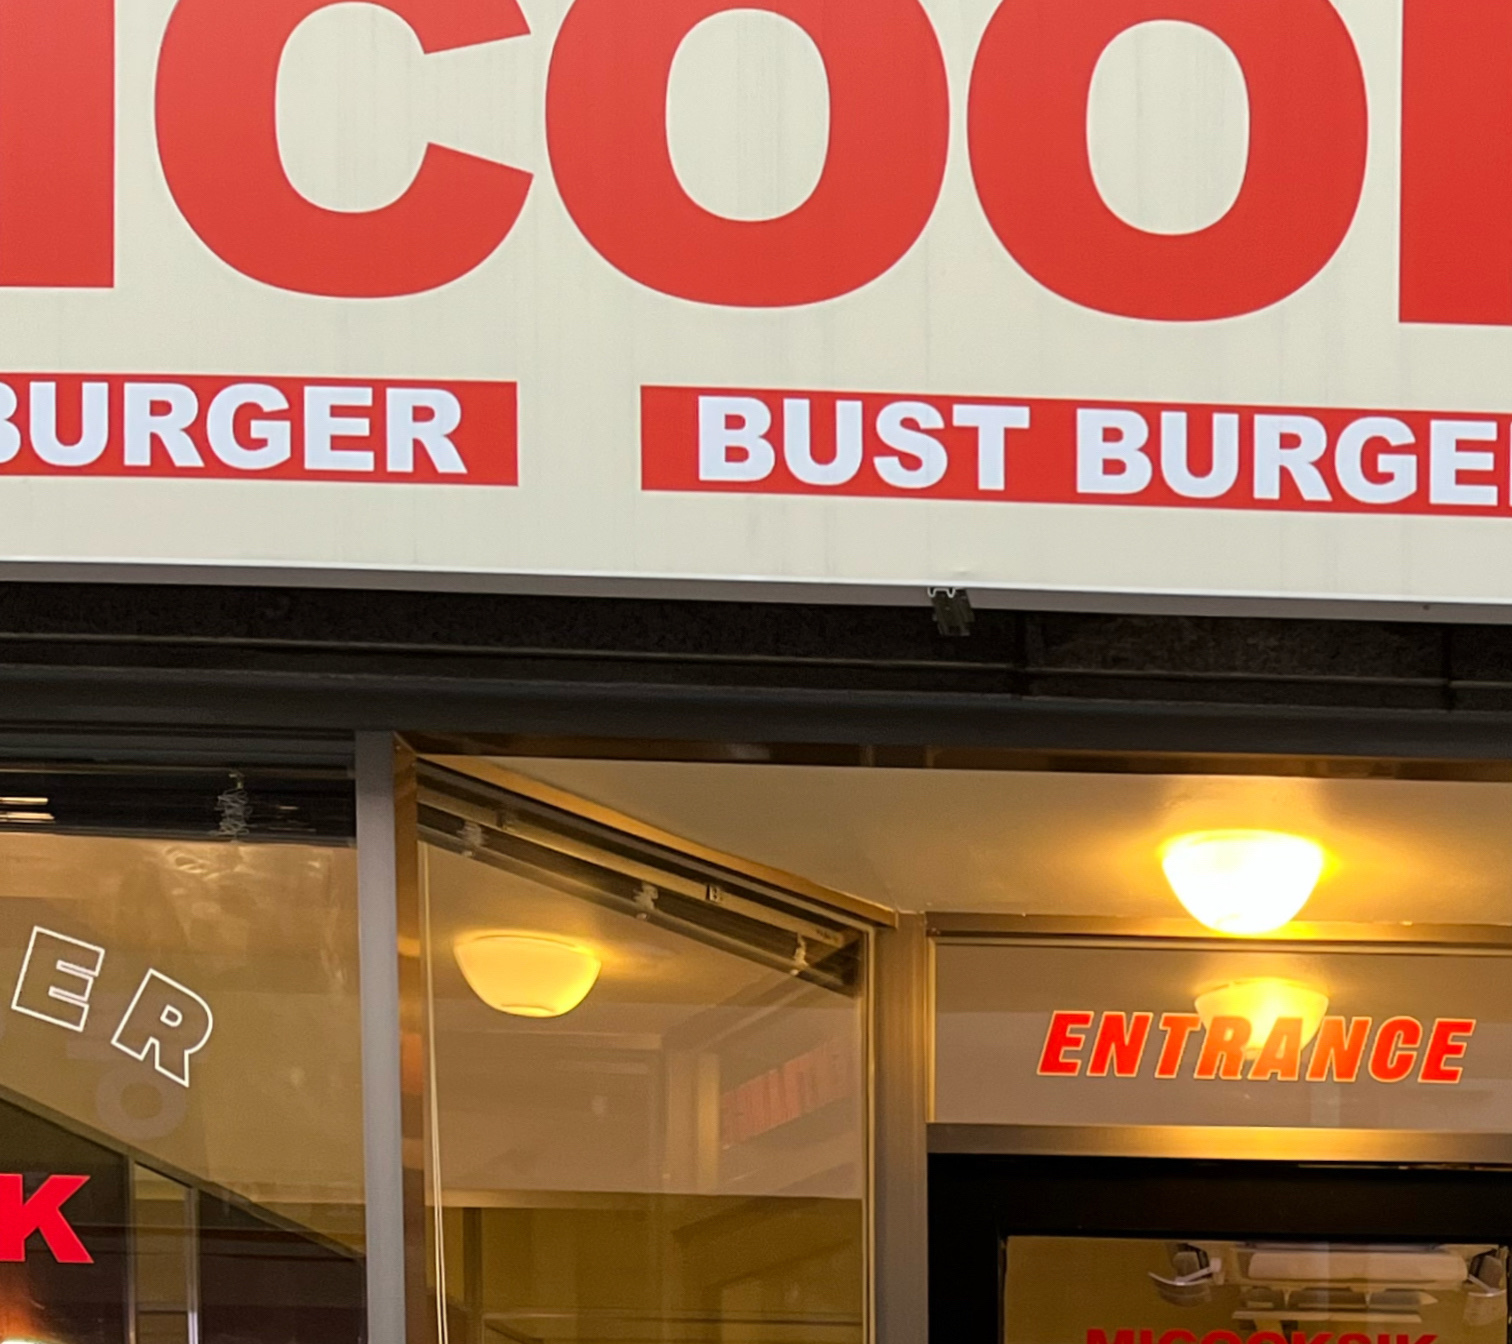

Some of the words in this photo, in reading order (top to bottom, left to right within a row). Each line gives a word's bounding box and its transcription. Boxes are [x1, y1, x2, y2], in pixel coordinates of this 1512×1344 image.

[0, 381, 467, 474] URGER
[696, 394, 1029, 491] BUST
[1036, 1010, 1477, 1084] ENTRANCE
